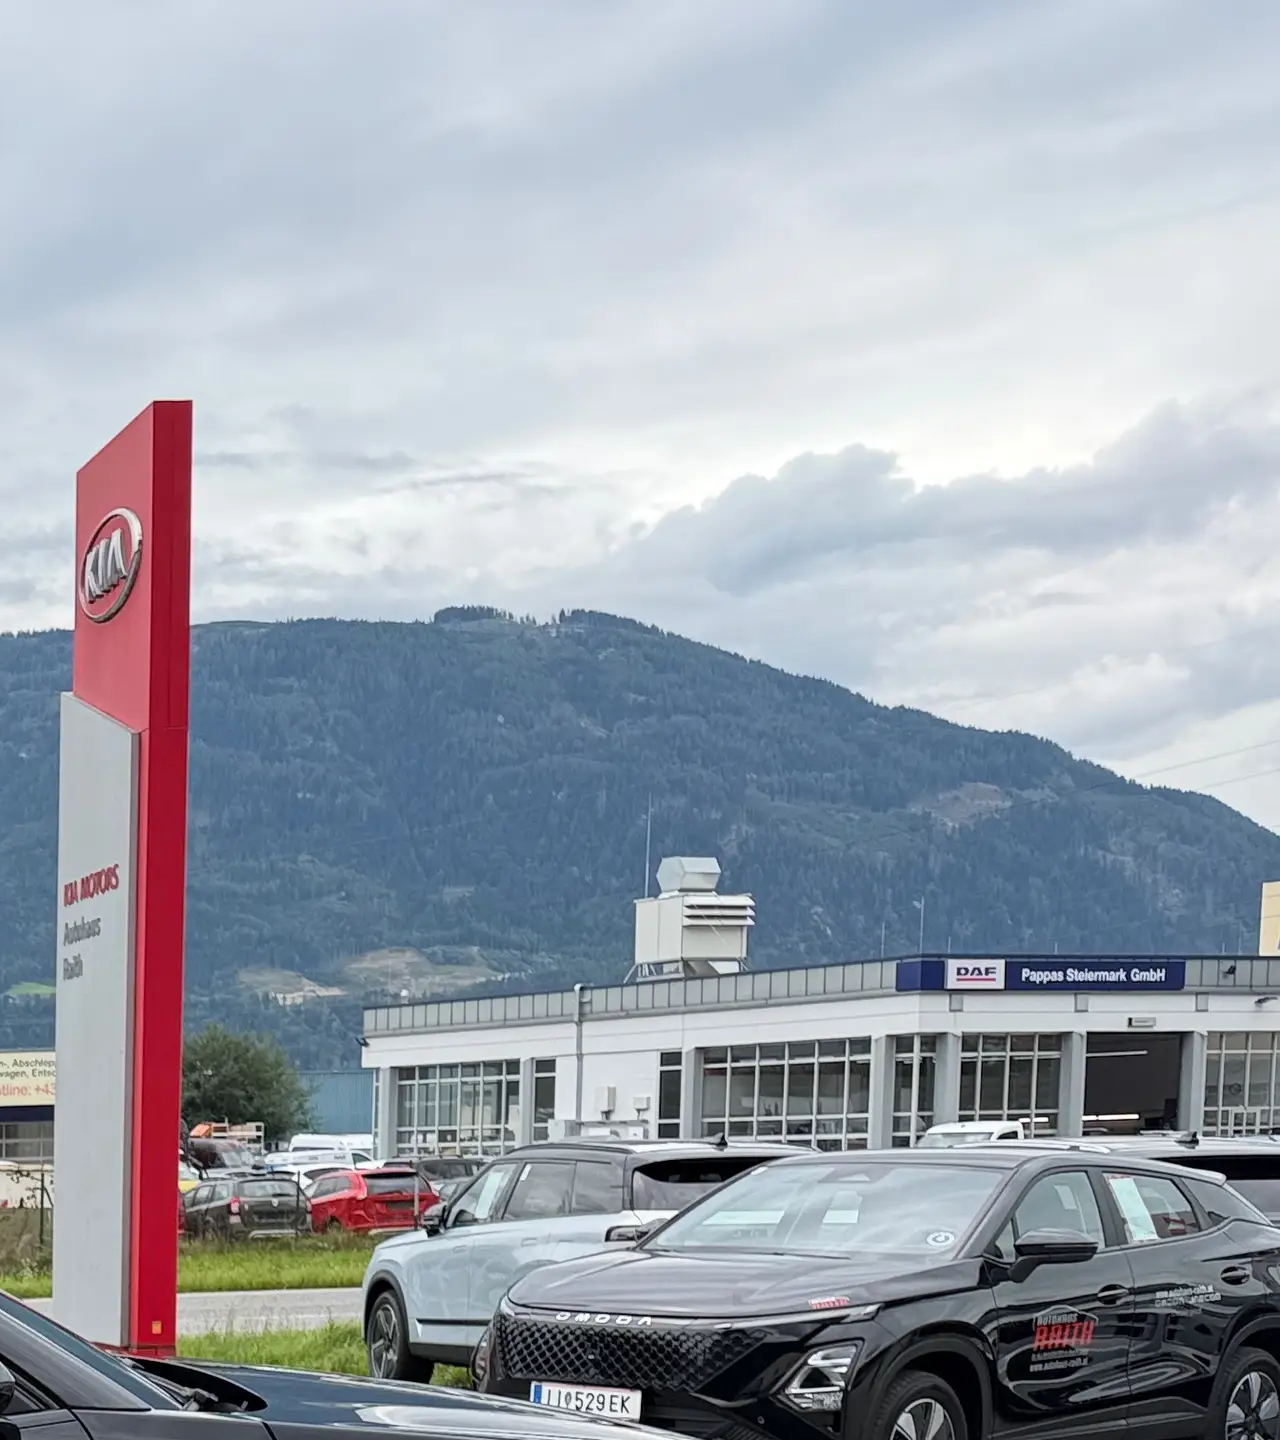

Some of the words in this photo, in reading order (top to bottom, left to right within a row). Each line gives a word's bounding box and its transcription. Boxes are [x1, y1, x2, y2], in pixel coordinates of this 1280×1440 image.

[85, 528, 127, 603] KIA
[63, 880, 79, 907] KIA
[80, 863, 120, 901] MOTORS
[63, 916, 101, 946] Autohaus
[63, 953, 83, 980] Raith
[956, 966, 997, 977] DAF
[1021, 968, 1064, 984] Pappas
[1066, 967, 1127, 983] Steiermark
[1130, 968, 1166, 983] GmbH
[555, 1311, 652, 1326] OMODA
[1037, 1313, 1079, 1327] AUTOHAUS
[1032, 1320, 1095, 1351] RAITH
[575, 1391, 606, 1412] 529
[610, 1395, 632, 1414] EK
